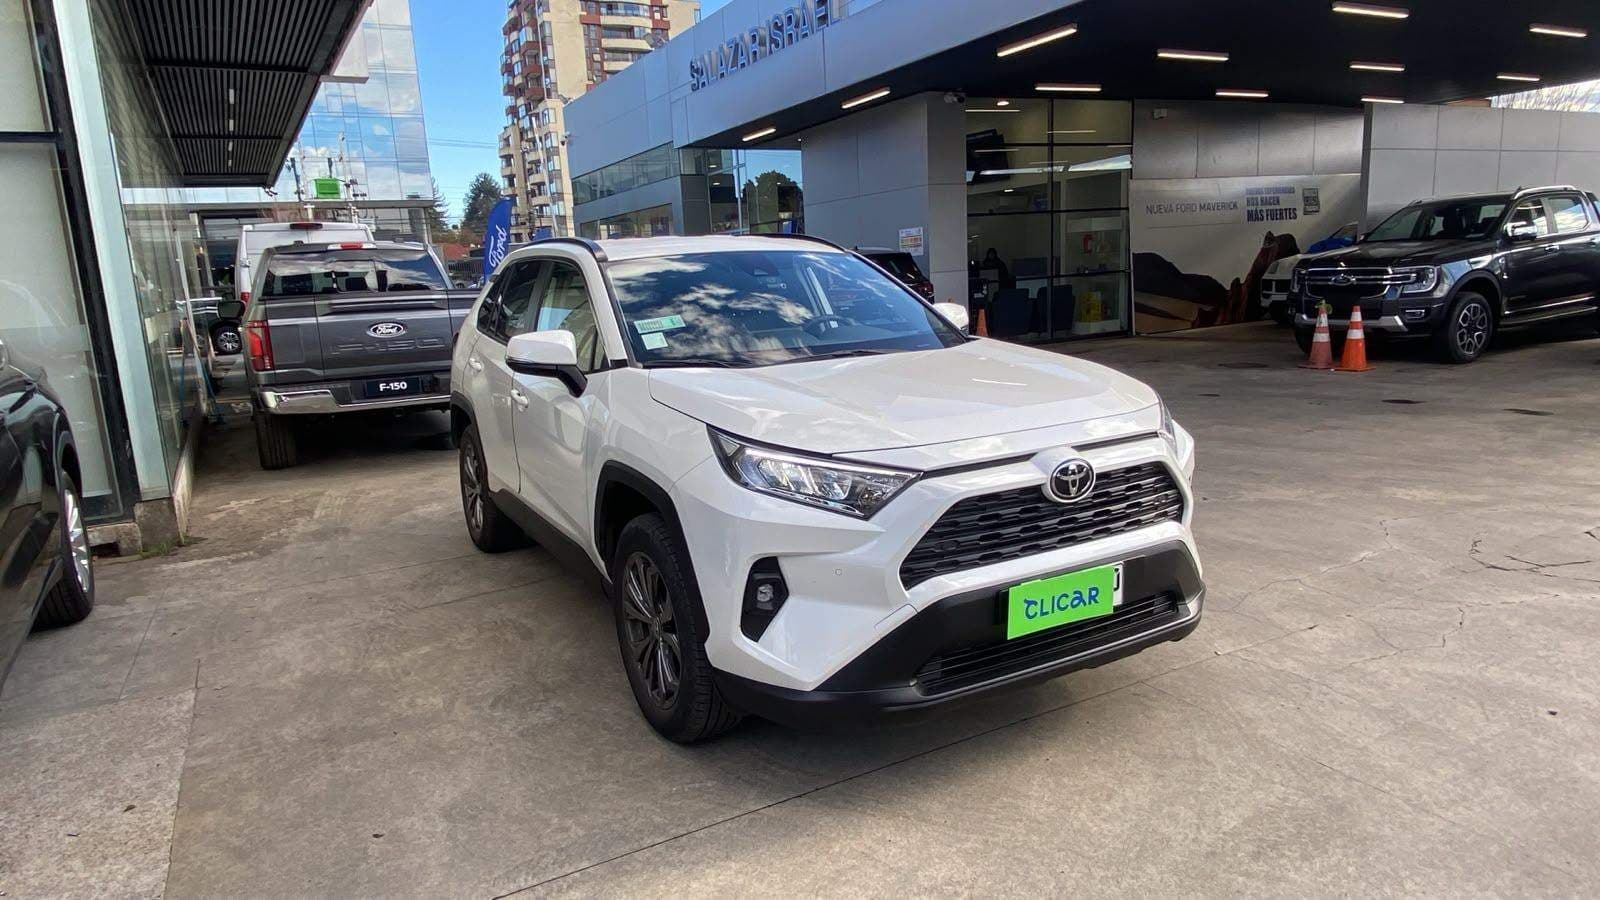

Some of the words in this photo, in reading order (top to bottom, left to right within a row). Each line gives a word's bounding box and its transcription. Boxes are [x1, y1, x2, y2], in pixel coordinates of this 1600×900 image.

[690, 26, 766, 92] SALAZAR
[767, 0, 841, 55] ISRAEL
[1146, 204, 1173, 215] NUEVA
[1175, 203, 1198, 214] FORD
[1199, 201, 1238, 211] MAVERICK
[1247, 207, 1264, 222] MÁS
[1265, 208, 1297, 221] FUERTES
[488, 224, 507, 267] Ford
[379, 381, 407, 391] F-150
